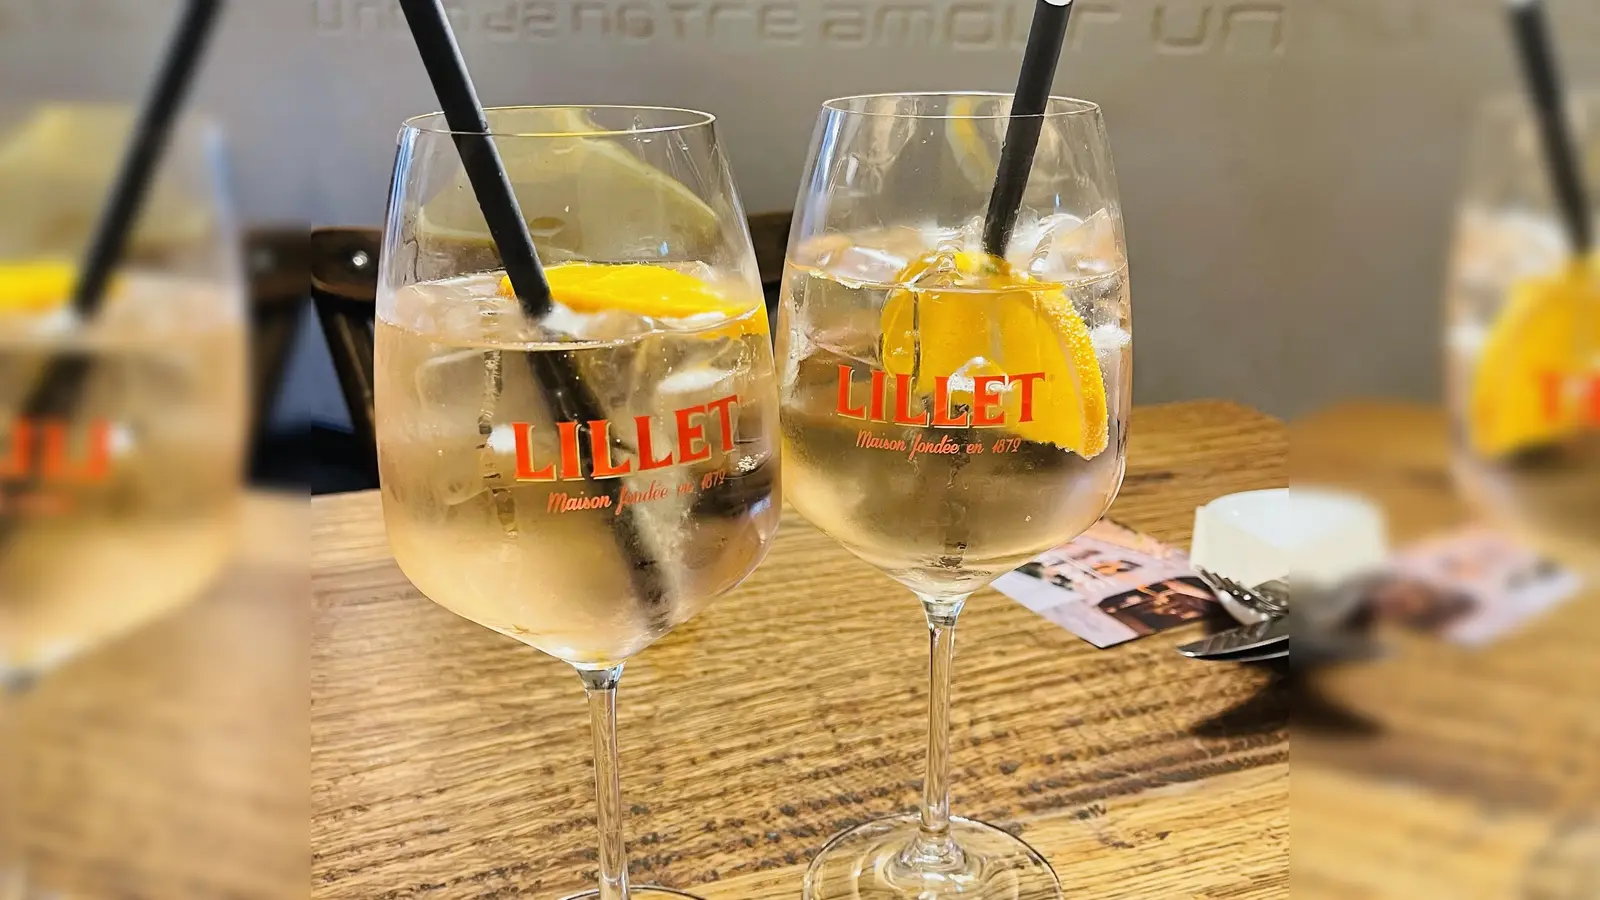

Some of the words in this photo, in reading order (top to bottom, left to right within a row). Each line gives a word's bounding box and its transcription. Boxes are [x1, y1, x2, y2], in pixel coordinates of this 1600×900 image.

[836, 364, 1046, 428] LILLET
[512, 394, 738, 482] LILLET
[856, 429, 907, 451] Maison
[909, 434, 960, 461] fondée
[966, 443, 984, 455] en
[546, 491, 612, 513] Maison
[615, 480, 668, 516] fondée
